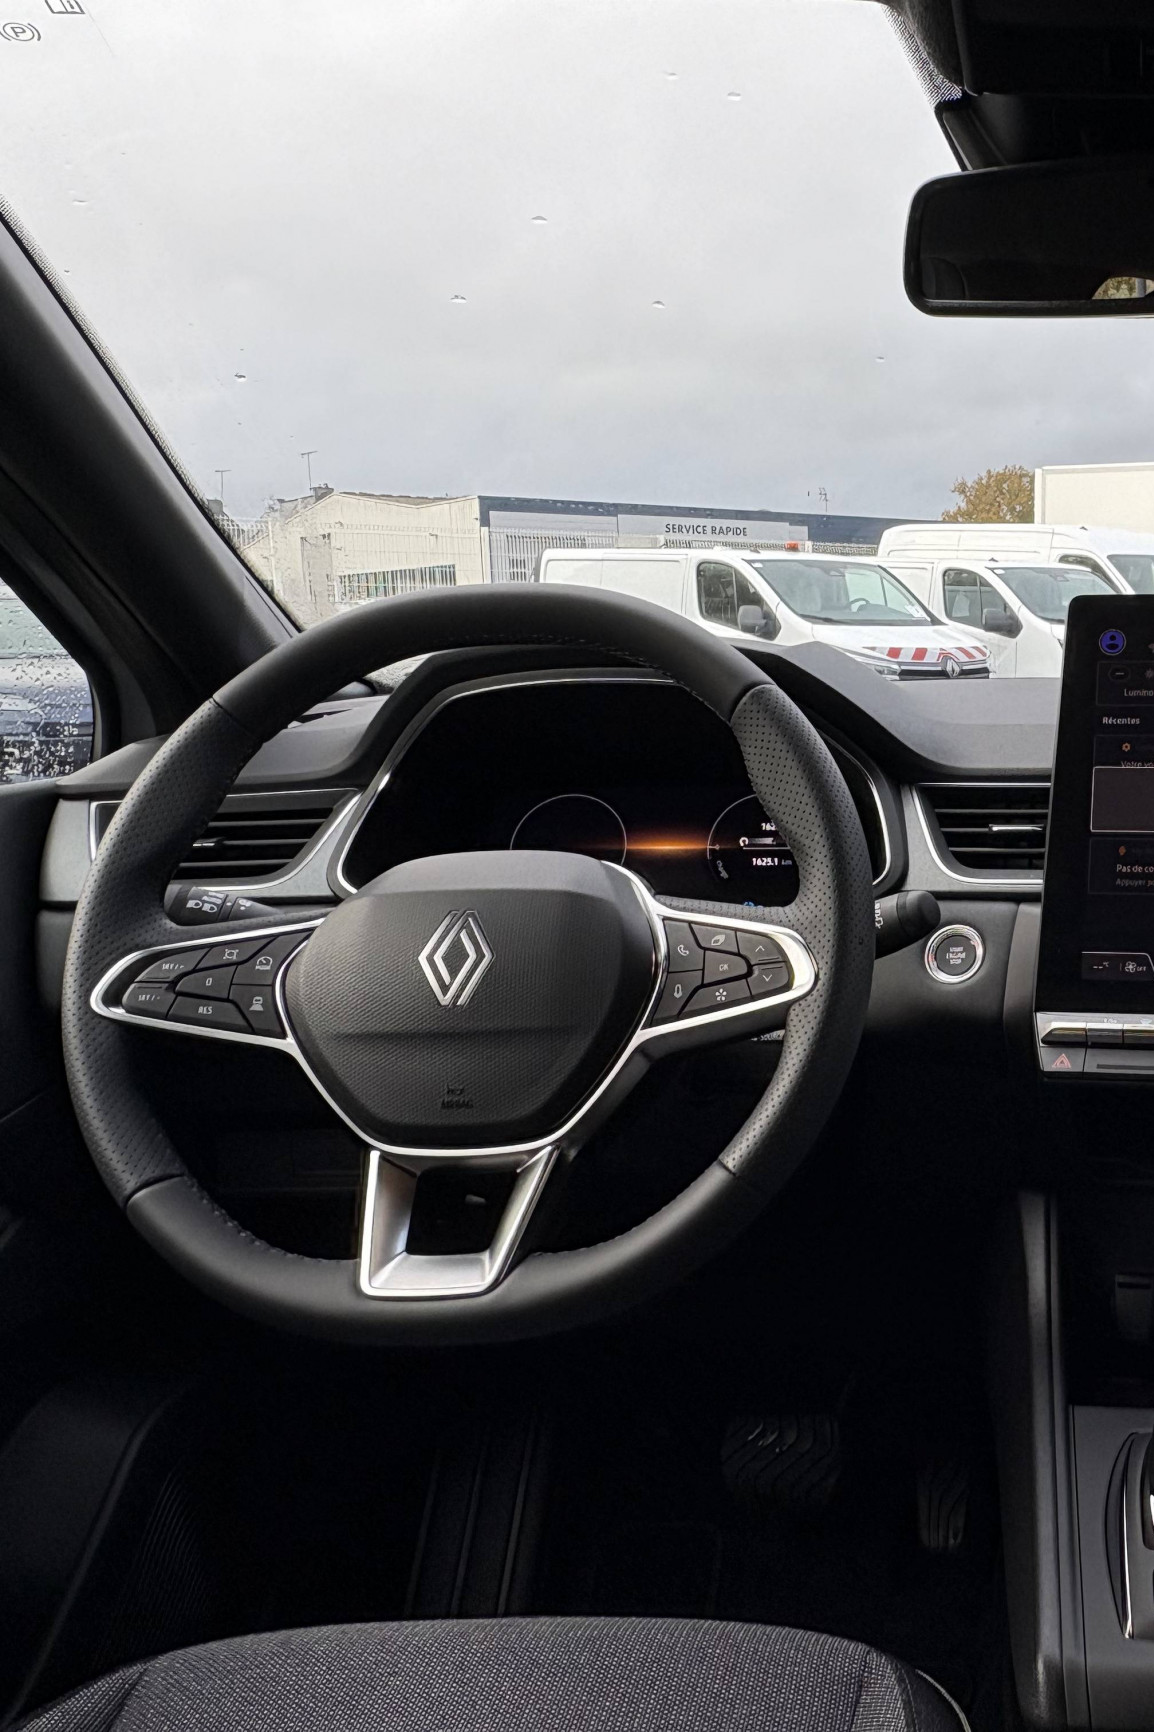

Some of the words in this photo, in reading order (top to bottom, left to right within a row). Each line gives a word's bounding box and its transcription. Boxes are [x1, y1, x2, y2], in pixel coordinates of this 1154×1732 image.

[665, 523, 707, 535] SERVICE
[711, 525, 747, 537] RAPIDE
[1116, 864, 1131, 873] Pas
[1132, 864, 1143, 873] de
